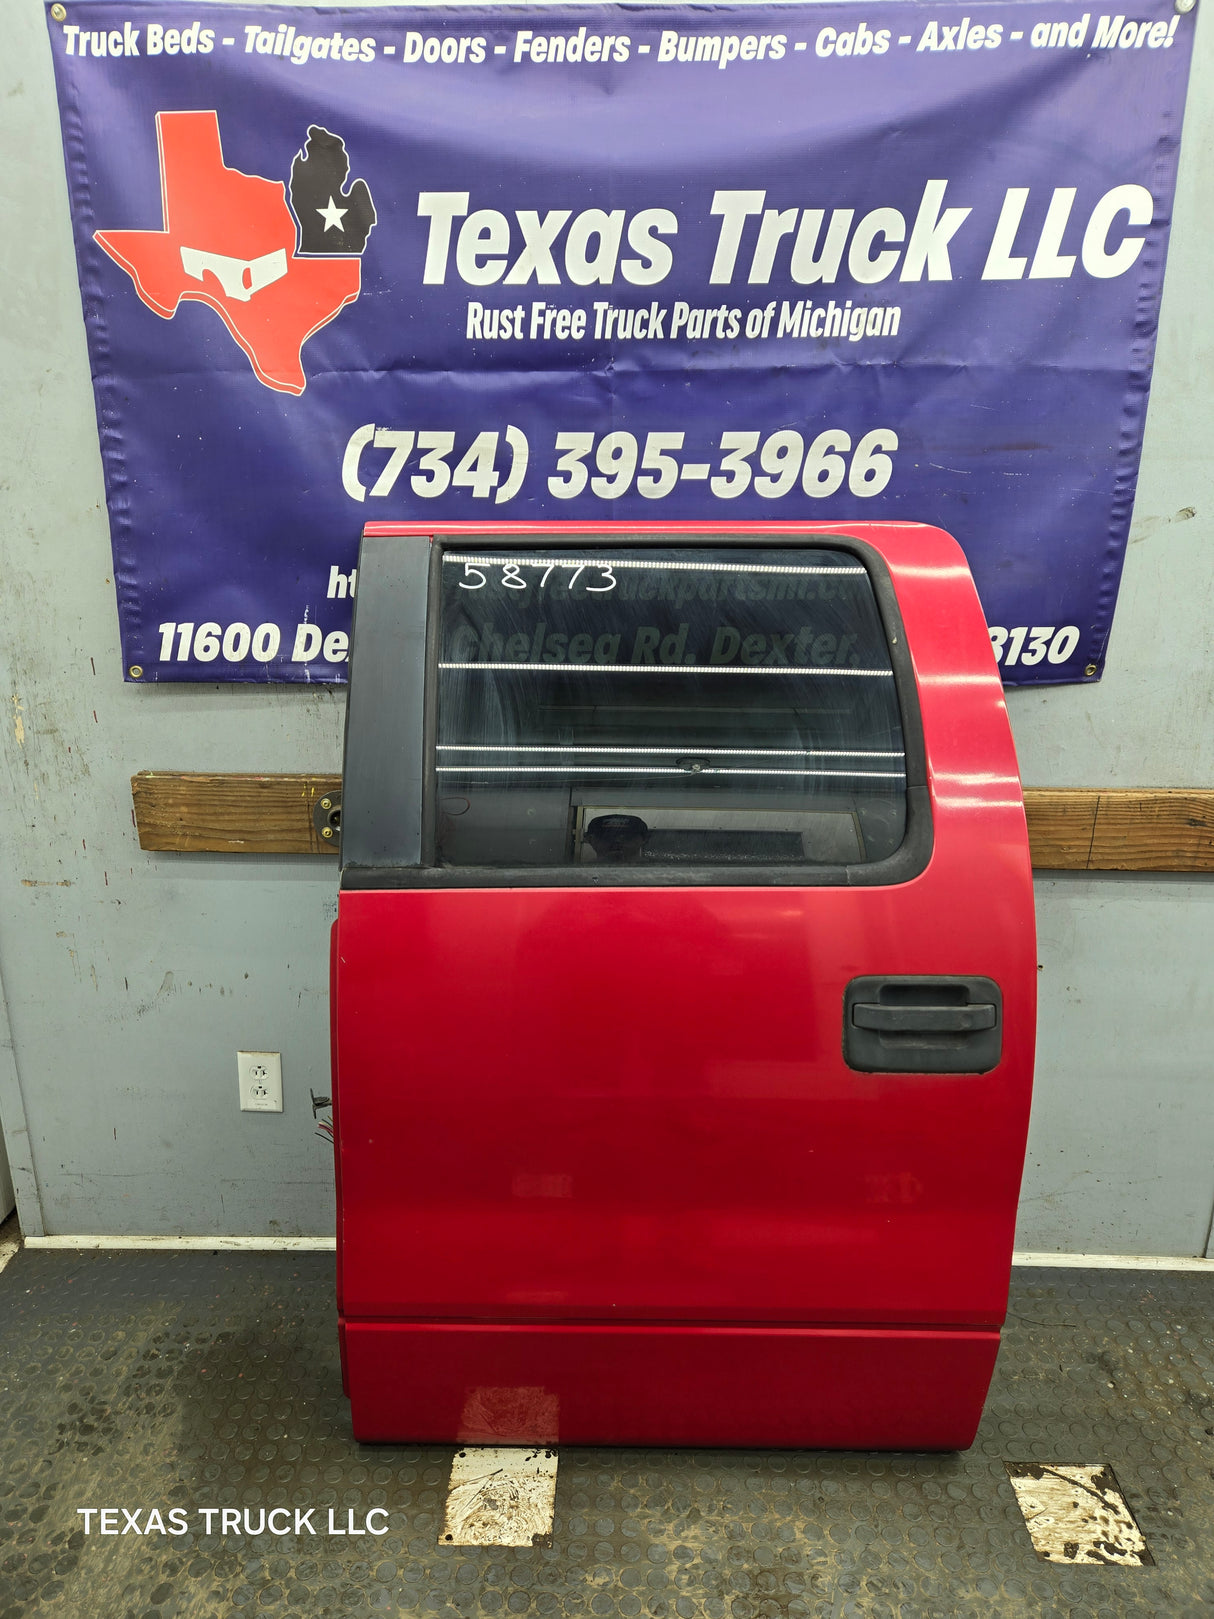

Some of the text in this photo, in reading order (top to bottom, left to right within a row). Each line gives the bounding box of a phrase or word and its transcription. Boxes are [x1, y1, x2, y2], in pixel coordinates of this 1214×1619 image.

[63, 22, 139, 56] Truck
[147, 22, 215, 55] Beds
[245, 24, 376, 64] Tailgates
[404, 32, 486, 63] Doors
[514, 27, 630, 62] Fenders
[658, 31, 787, 69] Bumpers
[815, 23, 891, 57] Cabs
[916, 17, 1003, 51] Axles
[1031, 13, 1091, 47] and
[1092, 15, 1180, 48] More!
[417, 180, 1153, 285] Texas Truck LLC
[467, 300, 901, 341] Rust Free Truck Parts of Michigan
[342, 424, 898, 503] (734) 395-3966
[459, 563, 616, 591] 58773
[159, 623, 280, 661] 11600
[988, 626, 1079, 665] 8130
